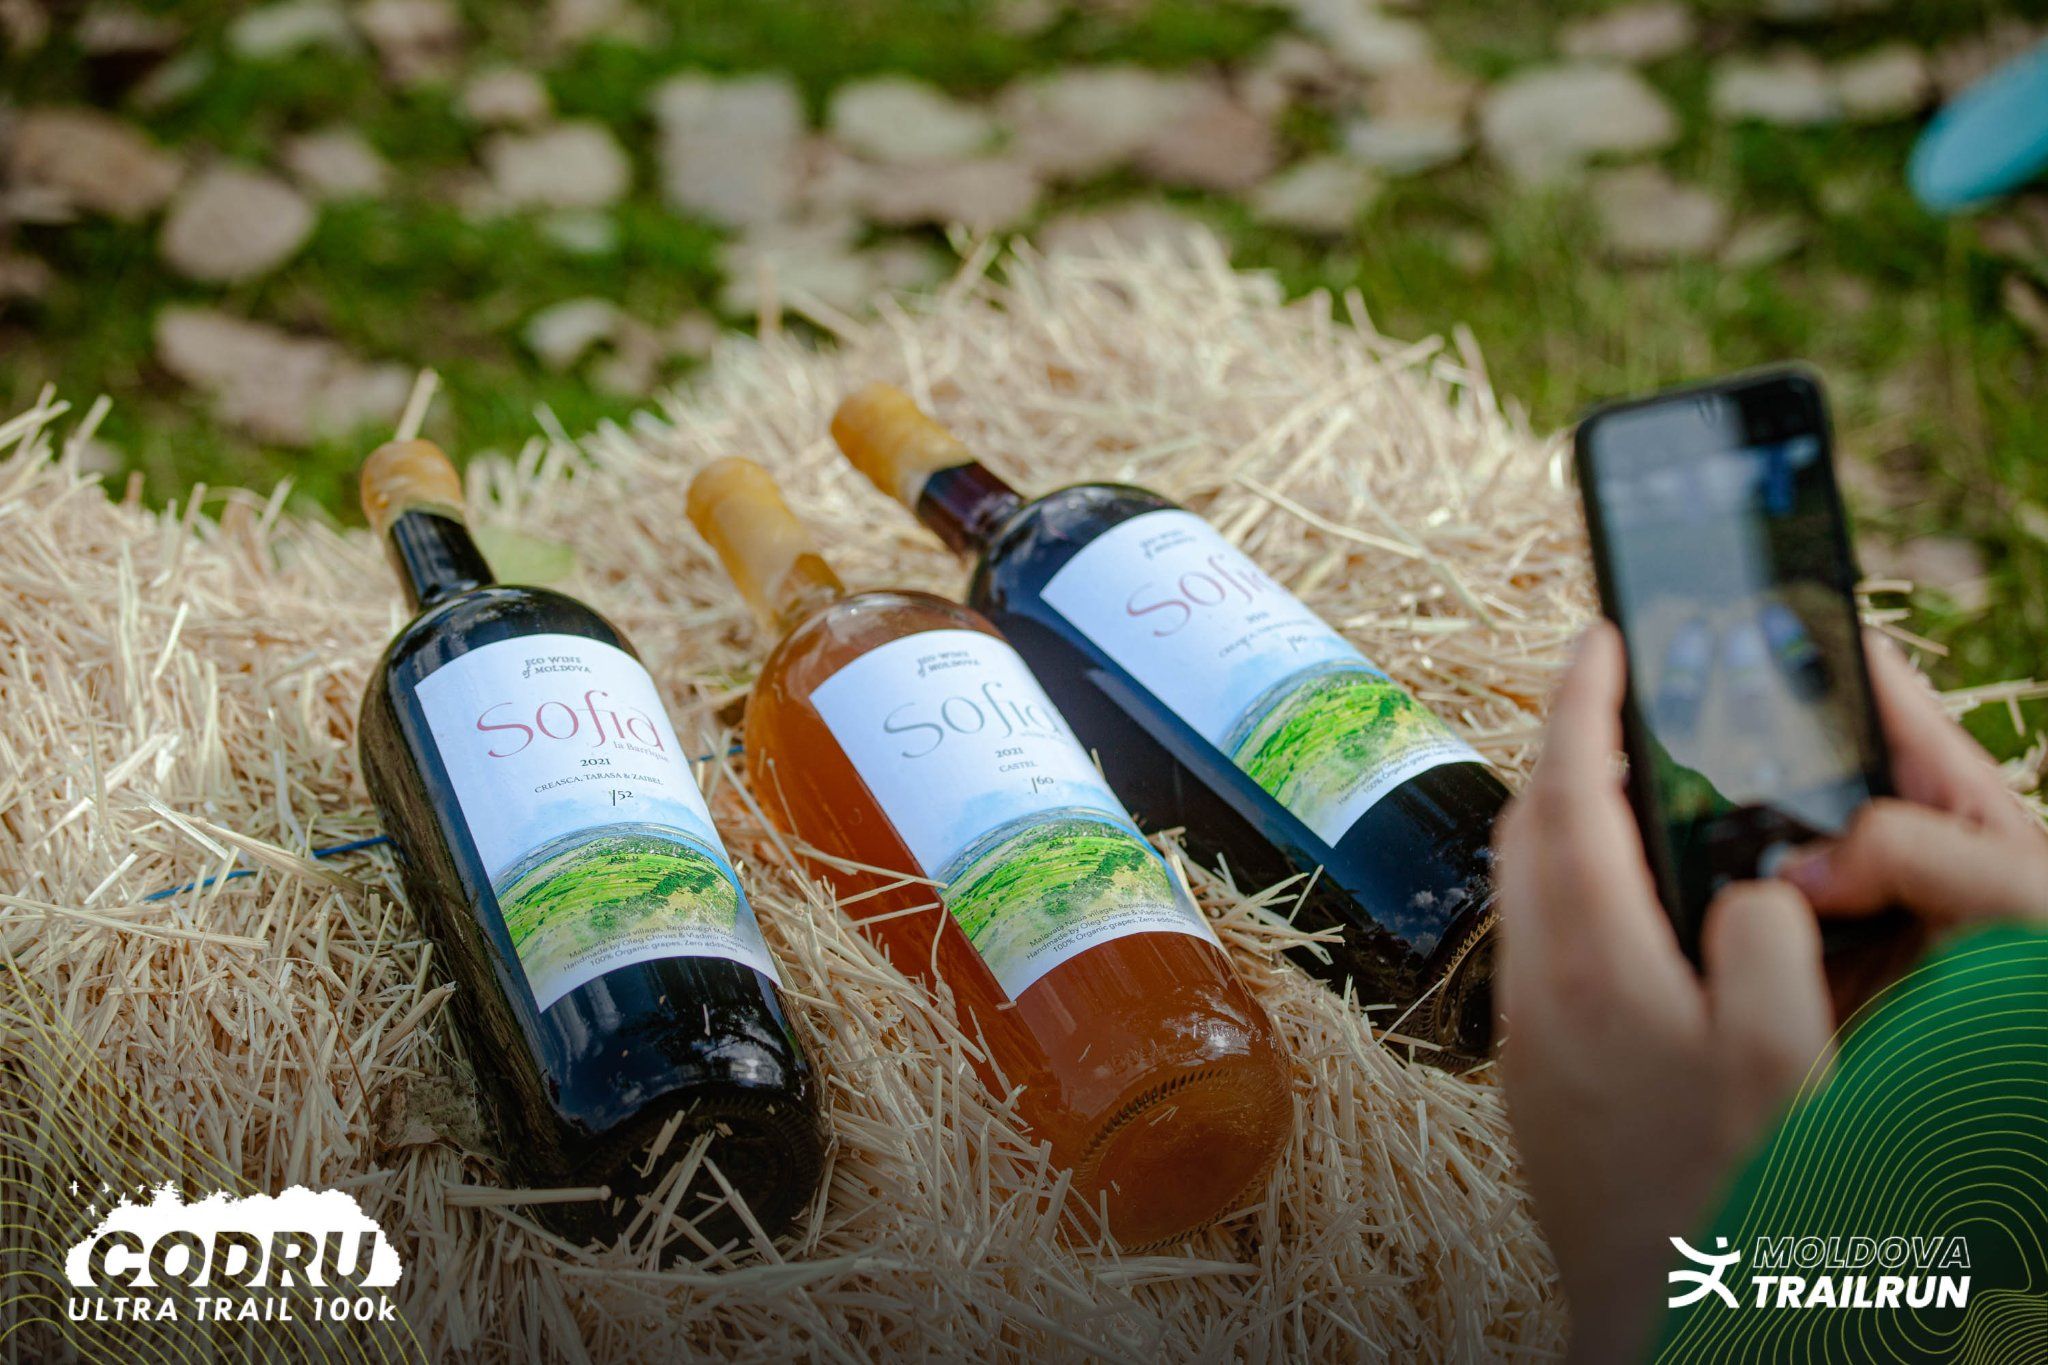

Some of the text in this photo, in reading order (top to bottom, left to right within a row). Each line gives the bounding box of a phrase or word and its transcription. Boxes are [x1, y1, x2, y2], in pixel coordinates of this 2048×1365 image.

[535, 664, 592, 674] MOLDOVA
[476, 689, 665, 758] Sofia
[580, 758, 611, 767] 2021
[995, 747, 1024, 758] 2021
[584, 772, 622, 781] TARASA
[999, 760, 1039, 773] CASTEL
[1026, 932, 1068, 960] Handmade
[1069, 926, 1080, 935] by
[1080, 919, 1101, 930] Oleg
[1029, 924, 1064, 947] Malovata
[1053, 939, 1075, 953] 100%
[1076, 926, 1108, 940] Organic
[563, 946, 608, 972] Handmade
[609, 941, 620, 951] by
[622, 936, 645, 947] Oleg
[590, 953, 615, 966] 100%
[615, 944, 649, 957] Organic
